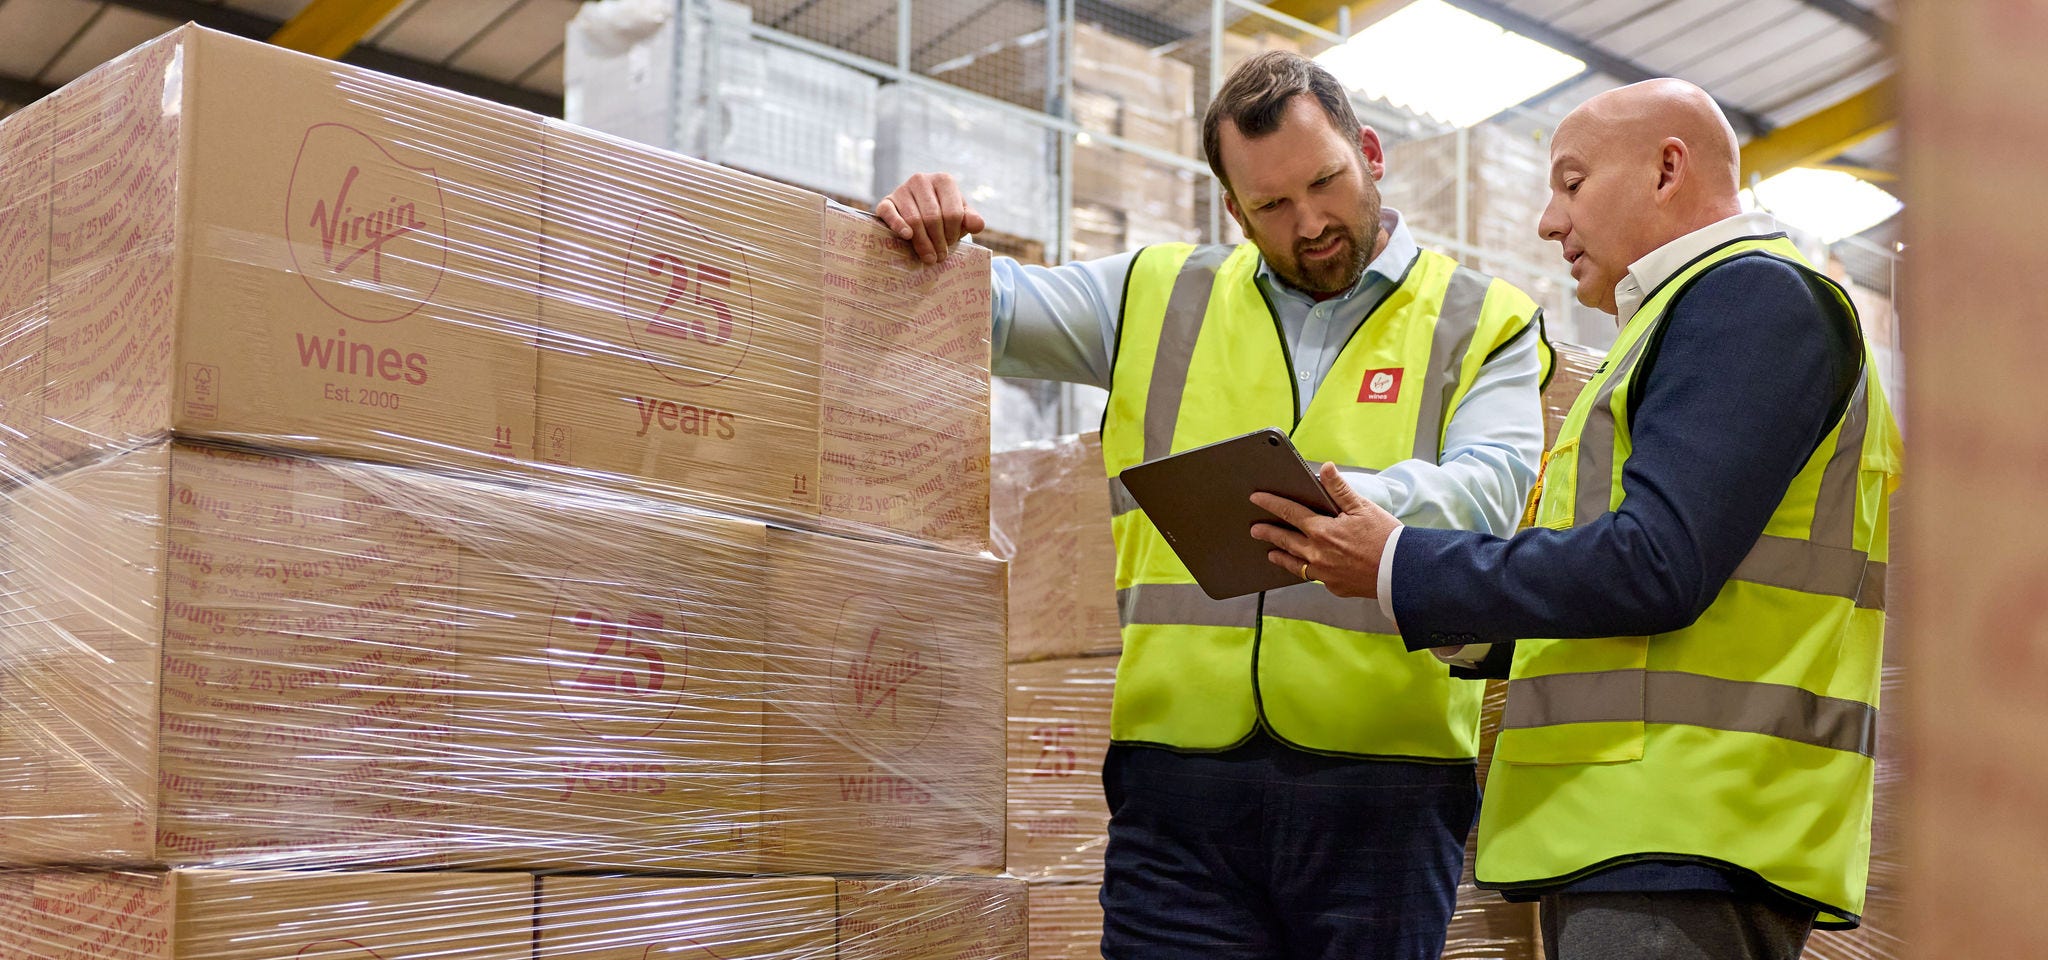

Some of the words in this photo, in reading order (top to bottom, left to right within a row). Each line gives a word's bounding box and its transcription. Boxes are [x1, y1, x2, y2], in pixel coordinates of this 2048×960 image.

[119, 117, 147, 167] young
[86, 217, 98, 239] 25
[99, 199, 123, 236] years
[124, 158, 152, 208] young
[310, 166, 426, 285] Virgin
[860, 233, 876, 251] 25
[878, 236, 902, 255] yea
[882, 277, 898, 292] 25
[899, 267, 931, 295] years
[931, 254, 966, 283] young
[94, 305, 119, 343] years
[119, 266, 148, 324] young
[646, 253, 734, 347] 25
[912, 304, 946, 333] young
[962, 288, 977, 305] 25
[978, 288, 990, 305] ye
[110, 334, 138, 382] young
[296, 329, 428, 387] wines
[931, 335, 966, 361] young
[324, 384, 353, 402] Est.
[360, 390, 401, 411] 2000
[635, 396, 736, 441] years
[880, 450, 897, 467] 25
[898, 438, 930, 468] years
[930, 420, 966, 451] young
[858, 495, 873, 512] 25
[875, 495, 909, 515] years
[909, 474, 946, 504] young
[962, 457, 978, 473] 25
[978, 455, 990, 473] ye
[271, 504, 294, 524] 25
[931, 506, 965, 537] young
[254, 558, 278, 580] 25
[281, 557, 332, 584] years
[165, 598, 226, 635] young
[570, 612, 665, 695] 25
[846, 626, 928, 726] Virgin
[248, 668, 273, 691] 25
[277, 669, 329, 696] years
[1031, 724, 1077, 779] 25
[559, 758, 667, 801] years
[837, 767, 932, 803] wines
[154, 827, 218, 861] young
[117, 886, 147, 928] young
